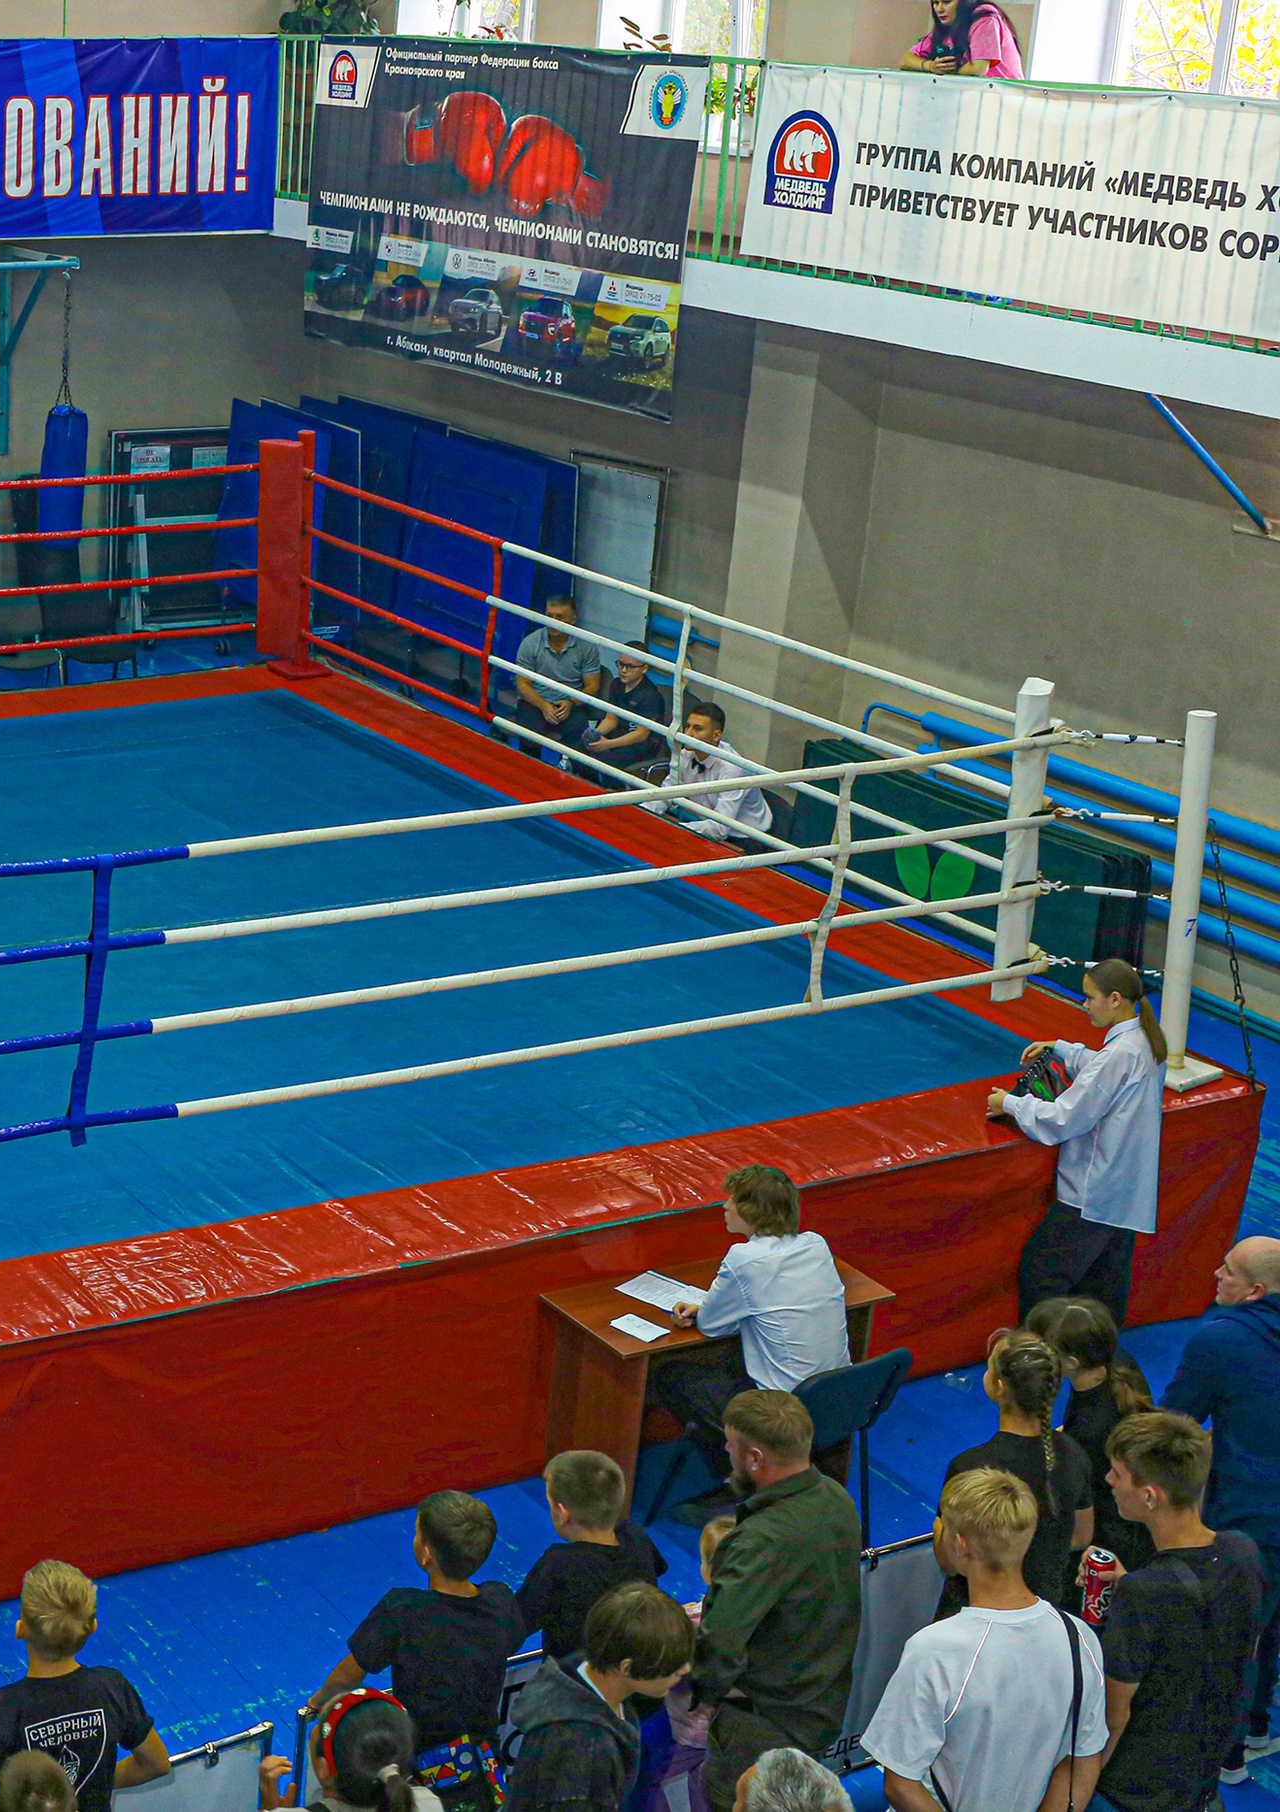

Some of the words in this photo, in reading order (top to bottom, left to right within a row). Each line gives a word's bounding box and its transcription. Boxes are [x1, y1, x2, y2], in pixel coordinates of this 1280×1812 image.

[384, 63, 443, 79] Красноярского
[445, 69, 466, 80] края
[444, 53, 479, 66] партнер
[480, 52, 530, 70] Федерации
[532, 56, 559, 70] бокса
[774, 177, 827, 197] МЕДВЕДЬ
[855, 141, 942, 175] ГРУППА
[950, 152, 1096, 192] КОМПАНИЙ
[1105, 170, 1247, 212] «МЕДВЕДЬ
[1255, 184, 1280, 213] Х
[772, 190, 826, 210] ХОЛДИНГ
[320, 190, 394, 215] ЧЕМПИОНАМИ
[396, 201, 411, 217] НЕ
[413, 204, 491, 232] РОЖДАЮТСЯ,
[494, 216, 583, 245] ЧЕМПИОНАМИ
[585, 231, 680, 261] СТАНОВЯТСЯ!
[849, 182, 1020, 227] ПРИВЕТСТВУЕТ
[1027, 205, 1209, 253] УЧАСТНИКОВ
[1218, 229, 1280, 263] СОР
[386, 335, 394, 346] г.
[433, 345, 472, 363] квартал
[474, 352, 542, 383] Молодежный,
[545, 370, 552, 383] 2
[29, 1713, 101, 1741] СЕВЕРНЫЙ
[39, 1728, 98, 1748] ЧЕЛОВЕК
